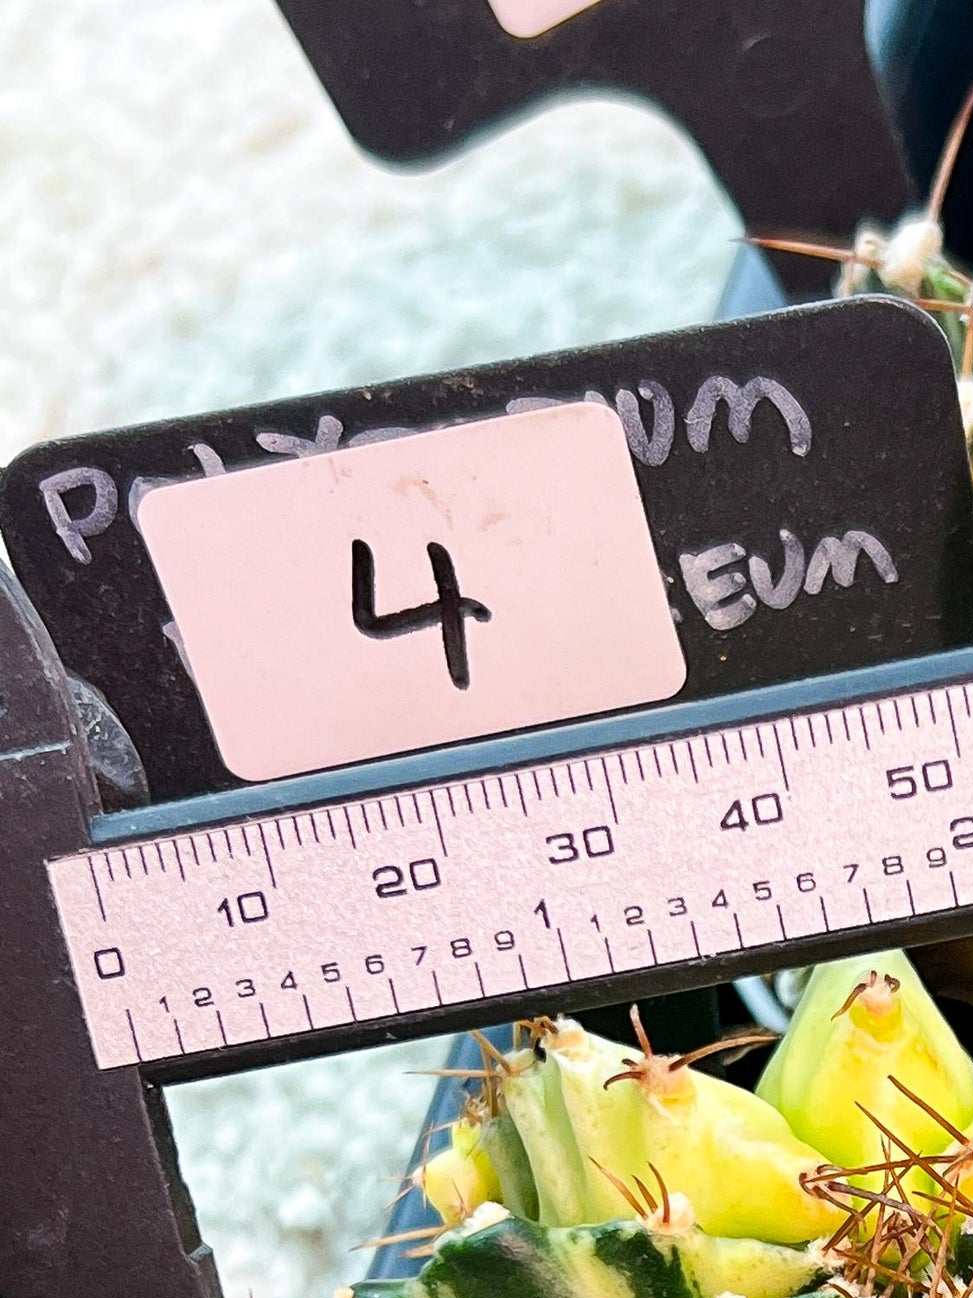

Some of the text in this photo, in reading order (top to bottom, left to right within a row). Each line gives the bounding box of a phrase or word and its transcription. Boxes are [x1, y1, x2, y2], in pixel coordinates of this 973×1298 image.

[351, 538, 492, 692] 4
[93, 946, 126, 980] 0
[217, 890, 269, 928] 10
[372, 857, 441, 899] 20
[545, 825, 615, 865] 30
[719, 792, 784, 832] 40
[885, 759, 953, 800] 50
[158, 995, 170, 1013] 1
[192, 987, 215, 1008] 2
[235, 978, 256, 998] 3
[280, 970, 298, 990] 4
[320, 961, 341, 983] 5
[364, 954, 385, 975] 6
[410, 945, 428, 966] 7
[449, 937, 473, 959] 8
[493, 930, 515, 952] 9
[533, 898, 551, 930] 1
[590, 914, 600, 932] 1
[623, 905, 645, 927] 2
[667, 896, 688, 917] 3
[711, 889, 729, 909] 4
[752, 880, 772, 901] 5
[796, 872, 817, 893] 6
[843, 863, 859, 883] 7
[881, 855, 904, 876] 8
[926, 847, 947, 869] 9
